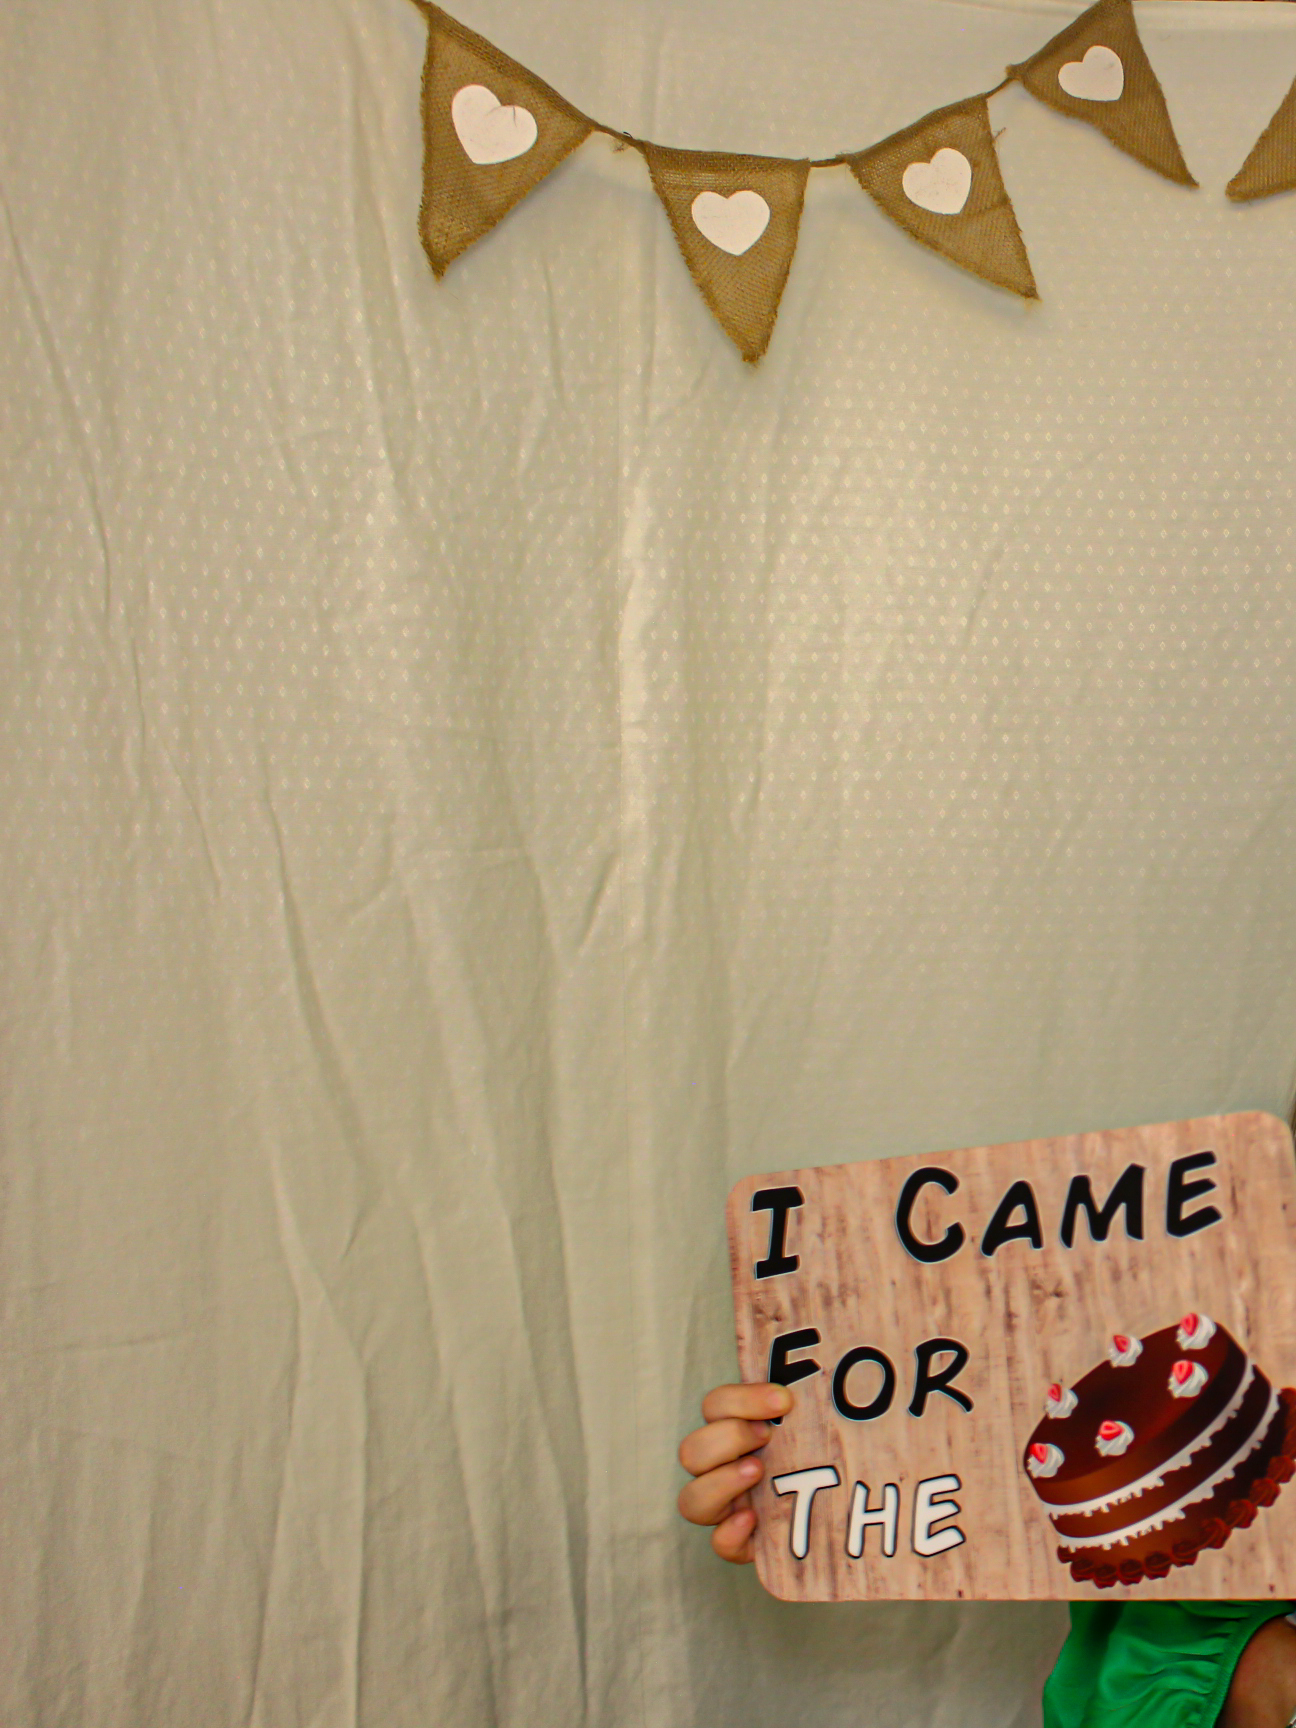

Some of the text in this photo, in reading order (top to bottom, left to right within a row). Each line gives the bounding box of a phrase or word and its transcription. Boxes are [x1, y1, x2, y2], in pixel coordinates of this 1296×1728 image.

[752, 1151, 1222, 1280] I CAME
[768, 1327, 974, 1426] FOR
[772, 1464, 966, 1559] THE
